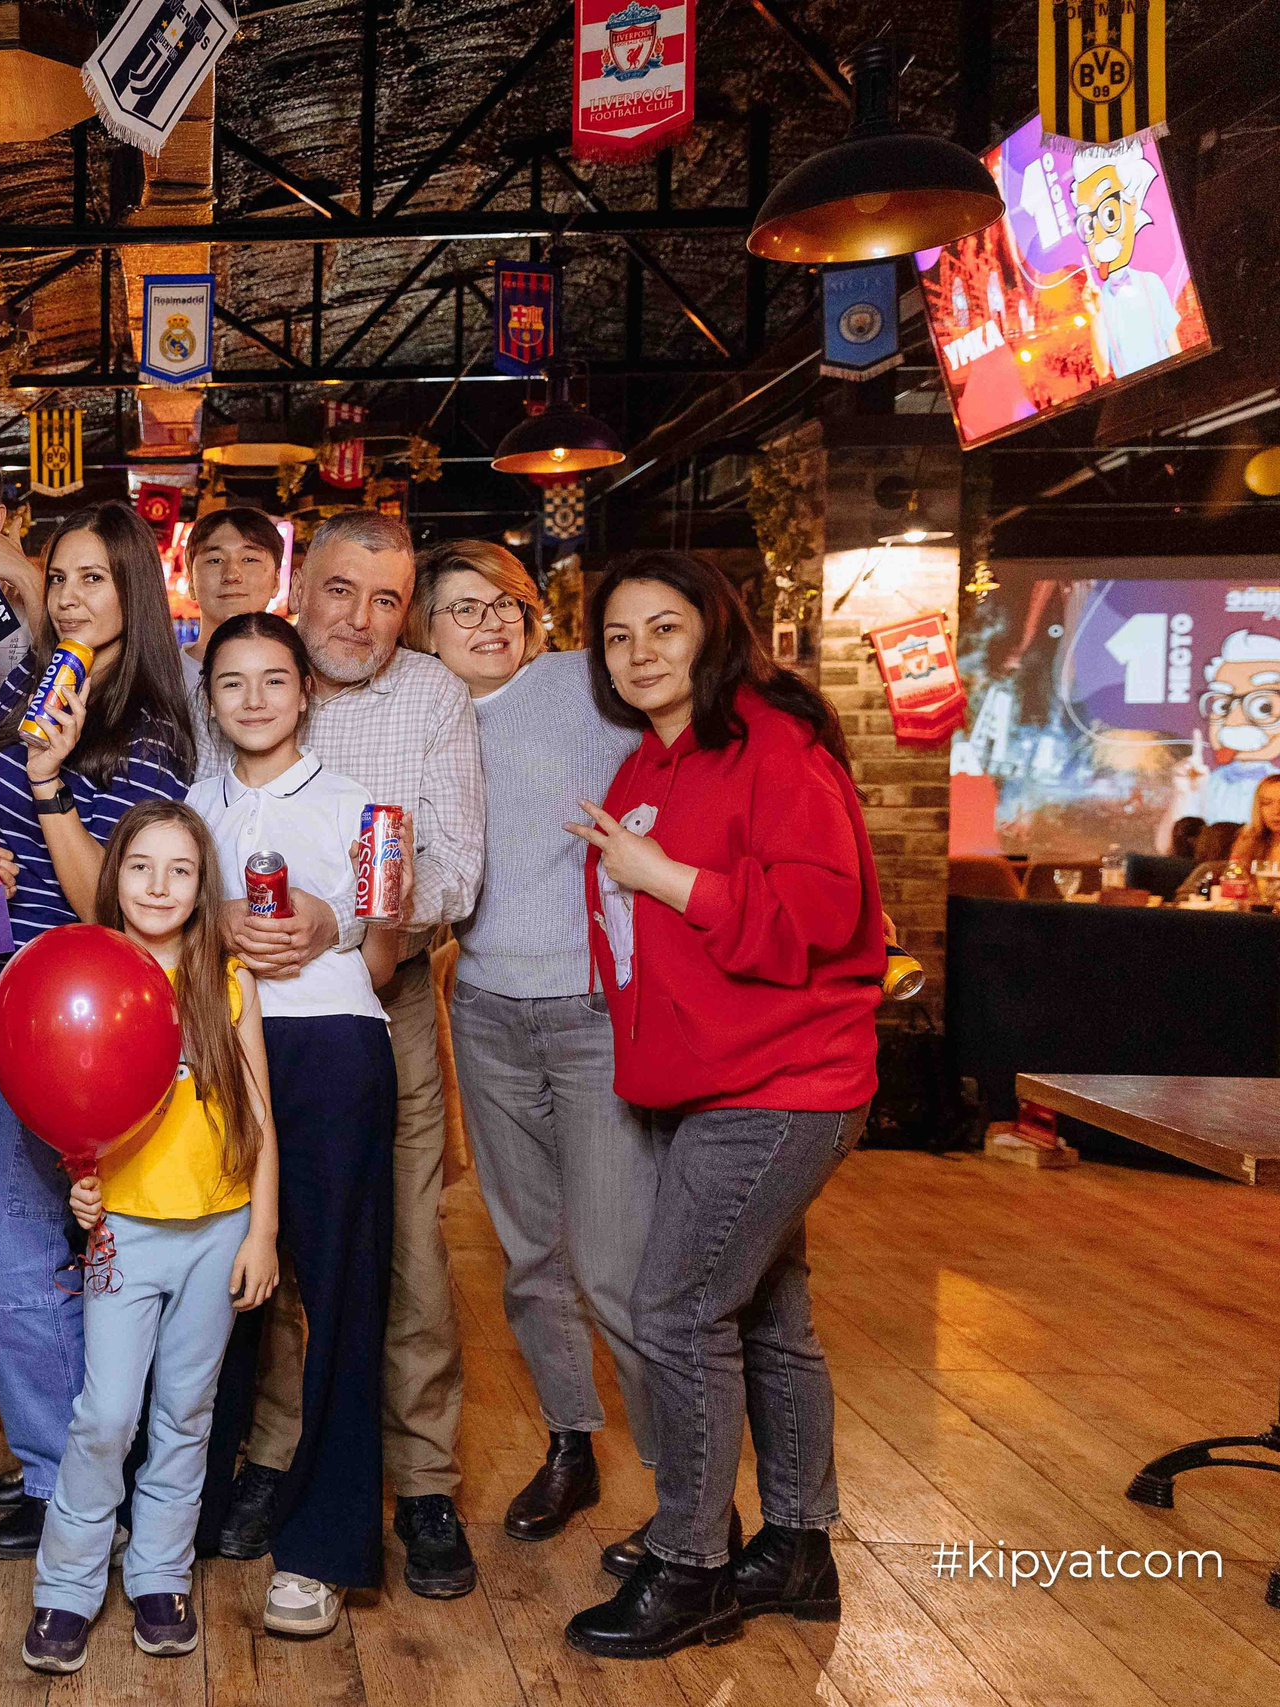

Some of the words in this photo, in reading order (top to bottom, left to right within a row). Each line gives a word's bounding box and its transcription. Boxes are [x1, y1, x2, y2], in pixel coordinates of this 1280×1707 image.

[153, 28, 178, 60] JUVENTUS
[164, 0, 210, 50] VENTUS
[613, 28, 653, 42] LIVERPOOL
[1080, 51, 1125, 87] BVB
[1093, 85, 1110, 98] 09
[590, 85, 673, 113] LIVERPOOL
[590, 107, 642, 122] FOOTBALL
[646, 100, 674, 113] CLUB
[1020, 158, 1061, 250] 1
[943, 319, 1005, 371] УМКА
[1105, 613, 1167, 703] 1
[1168, 613, 1193, 703] МЕСТО
[27, 653, 63, 716] DONAVI
[355, 831, 373, 910] ROSSA
